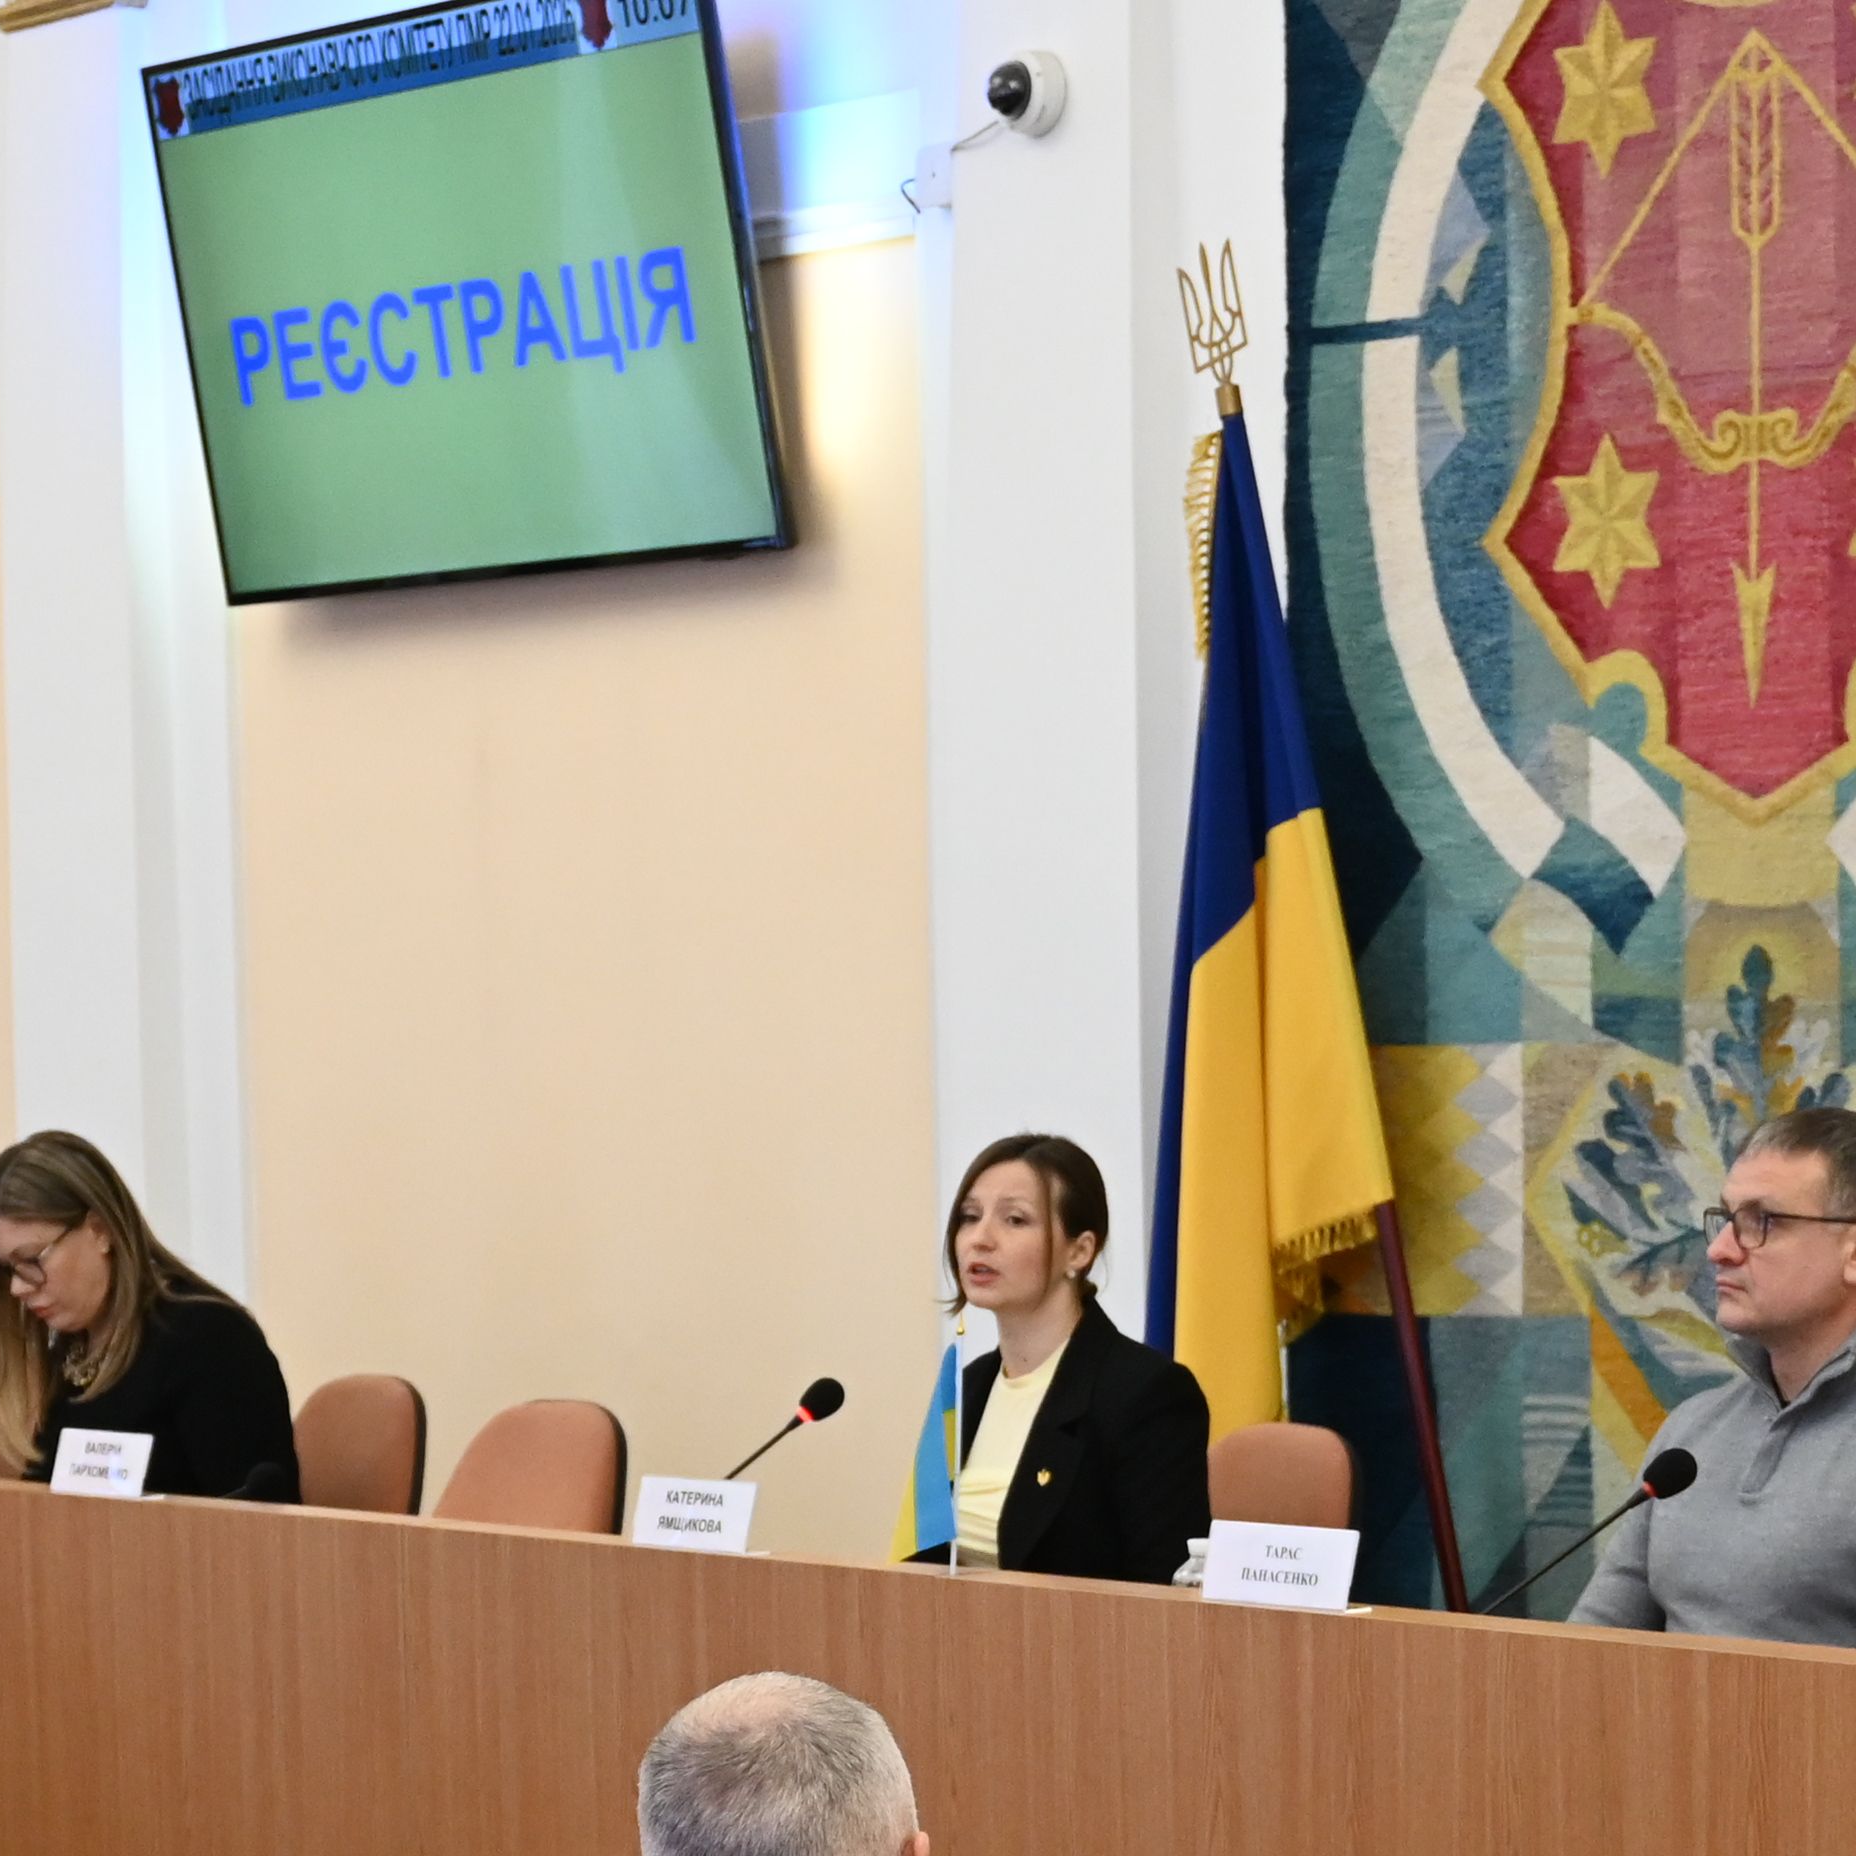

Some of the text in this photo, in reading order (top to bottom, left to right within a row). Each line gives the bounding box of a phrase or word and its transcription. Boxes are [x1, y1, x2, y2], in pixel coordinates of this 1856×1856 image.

[230, 246, 696, 406] РЕЄСТРАЦІЯ
[69, 1463, 129, 1481] ПАРХОМЕКО
[665, 1490, 724, 1507] КАТЕРИНА
[657, 1515, 722, 1533] ЯМЩИКОВА
[1265, 1545, 1303, 1561] ТАРАС
[1241, 1567, 1319, 1587] ПАНАСЕНКО
